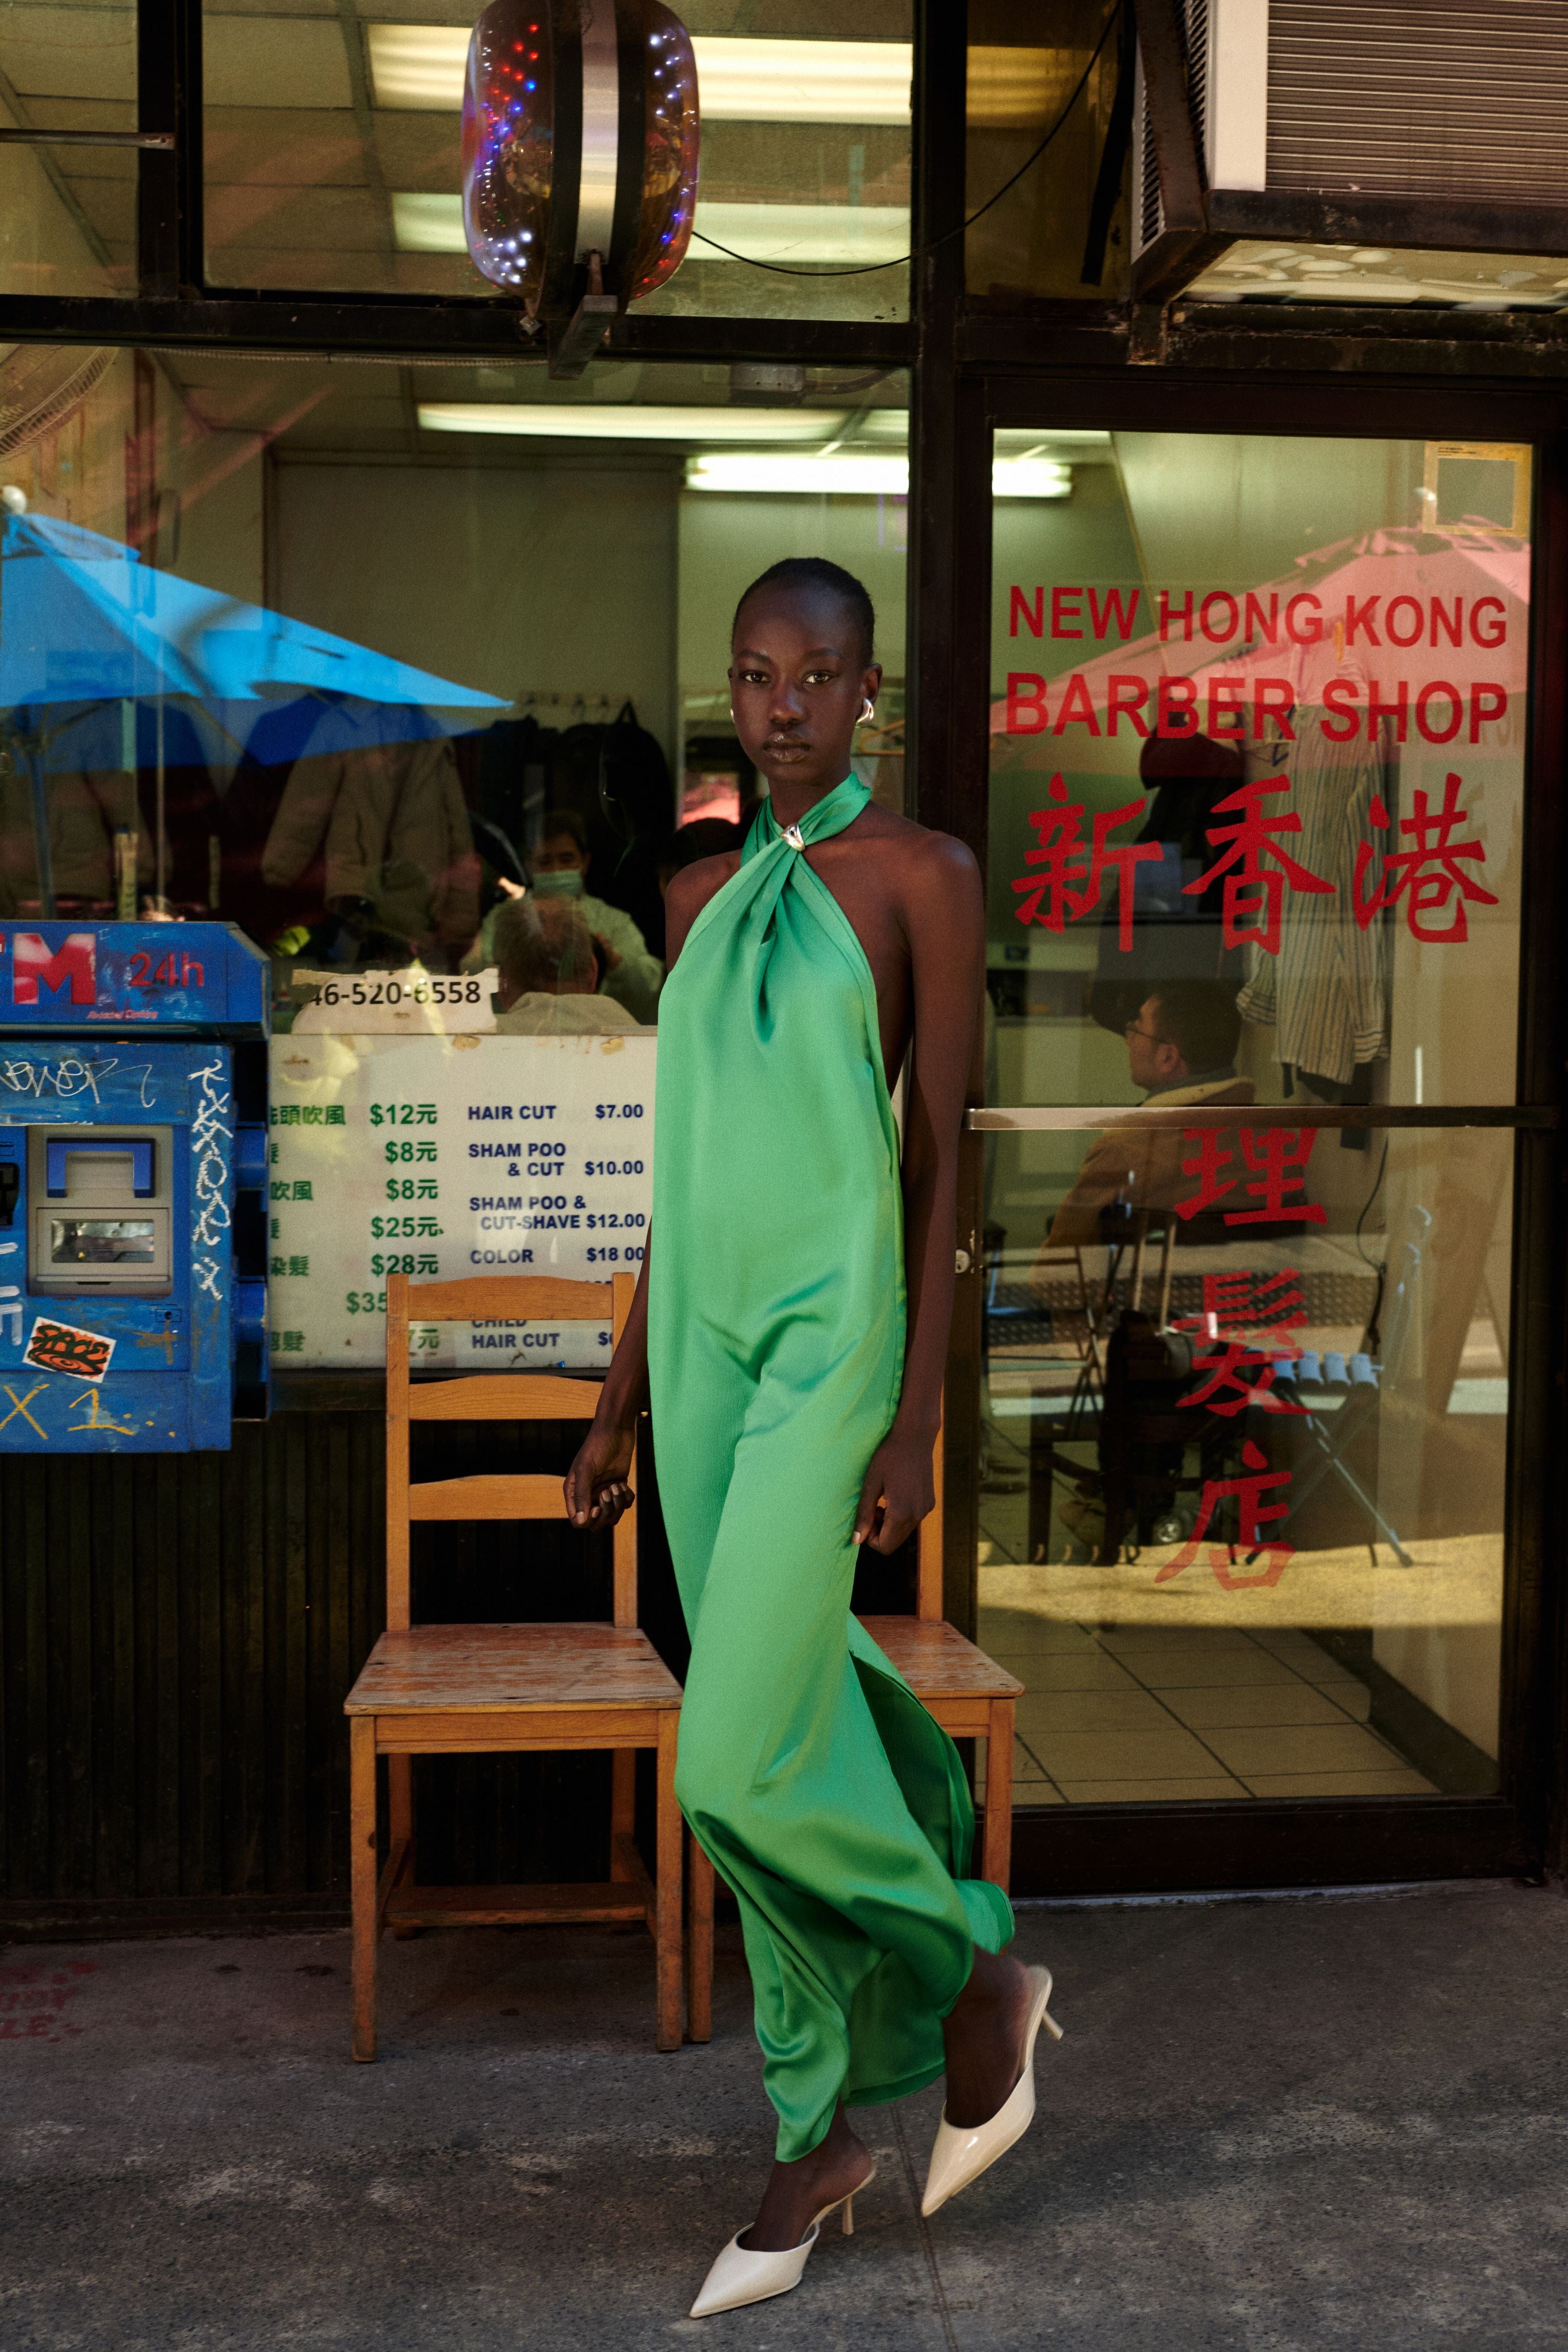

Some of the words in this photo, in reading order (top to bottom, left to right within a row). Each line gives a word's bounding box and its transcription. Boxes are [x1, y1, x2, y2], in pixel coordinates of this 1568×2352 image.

[1010, 586, 1140, 640] NEW
[1158, 589, 1323, 646] HONG
[1345, 595, 1506, 649] KONG
[1005, 672, 1297, 741] BARBER
[1319, 679, 1508, 744] SHOP
[1012, 772, 1499, 955] 新香港
[0, 933, 96, 1005] M
[130, 952, 205, 987] 24h
[370, 1103, 438, 1127] $12元
[468, 1105, 513, 1120] HAIR
[519, 1105, 557, 1120] CUT
[595, 1104, 644, 1120] $7.00
[384, 1141, 437, 1165] $8元
[468, 1143, 522, 1158] SHAM
[528, 1143, 566, 1157] POO
[507, 1162, 521, 1177] &
[527, 1162, 565, 1176] CUT
[584, 1160, 644, 1176] $10.00
[386, 1178, 438, 1202] $8元
[469, 1197, 523, 1212] SHAM
[529, 1196, 567, 1210] POO
[573, 1195, 587, 1209] &
[480, 1214, 581, 1230] CUT-SHAVE
[586, 1213, 645, 1229] $12.00
[371, 1253, 439, 1277] $28元
[469, 1248, 534, 1265] COLOR
[472, 1334, 517, 1349] HAIR
[523, 1333, 560, 1348] CUT
[1155, 1128, 1328, 1591] 理髮店
